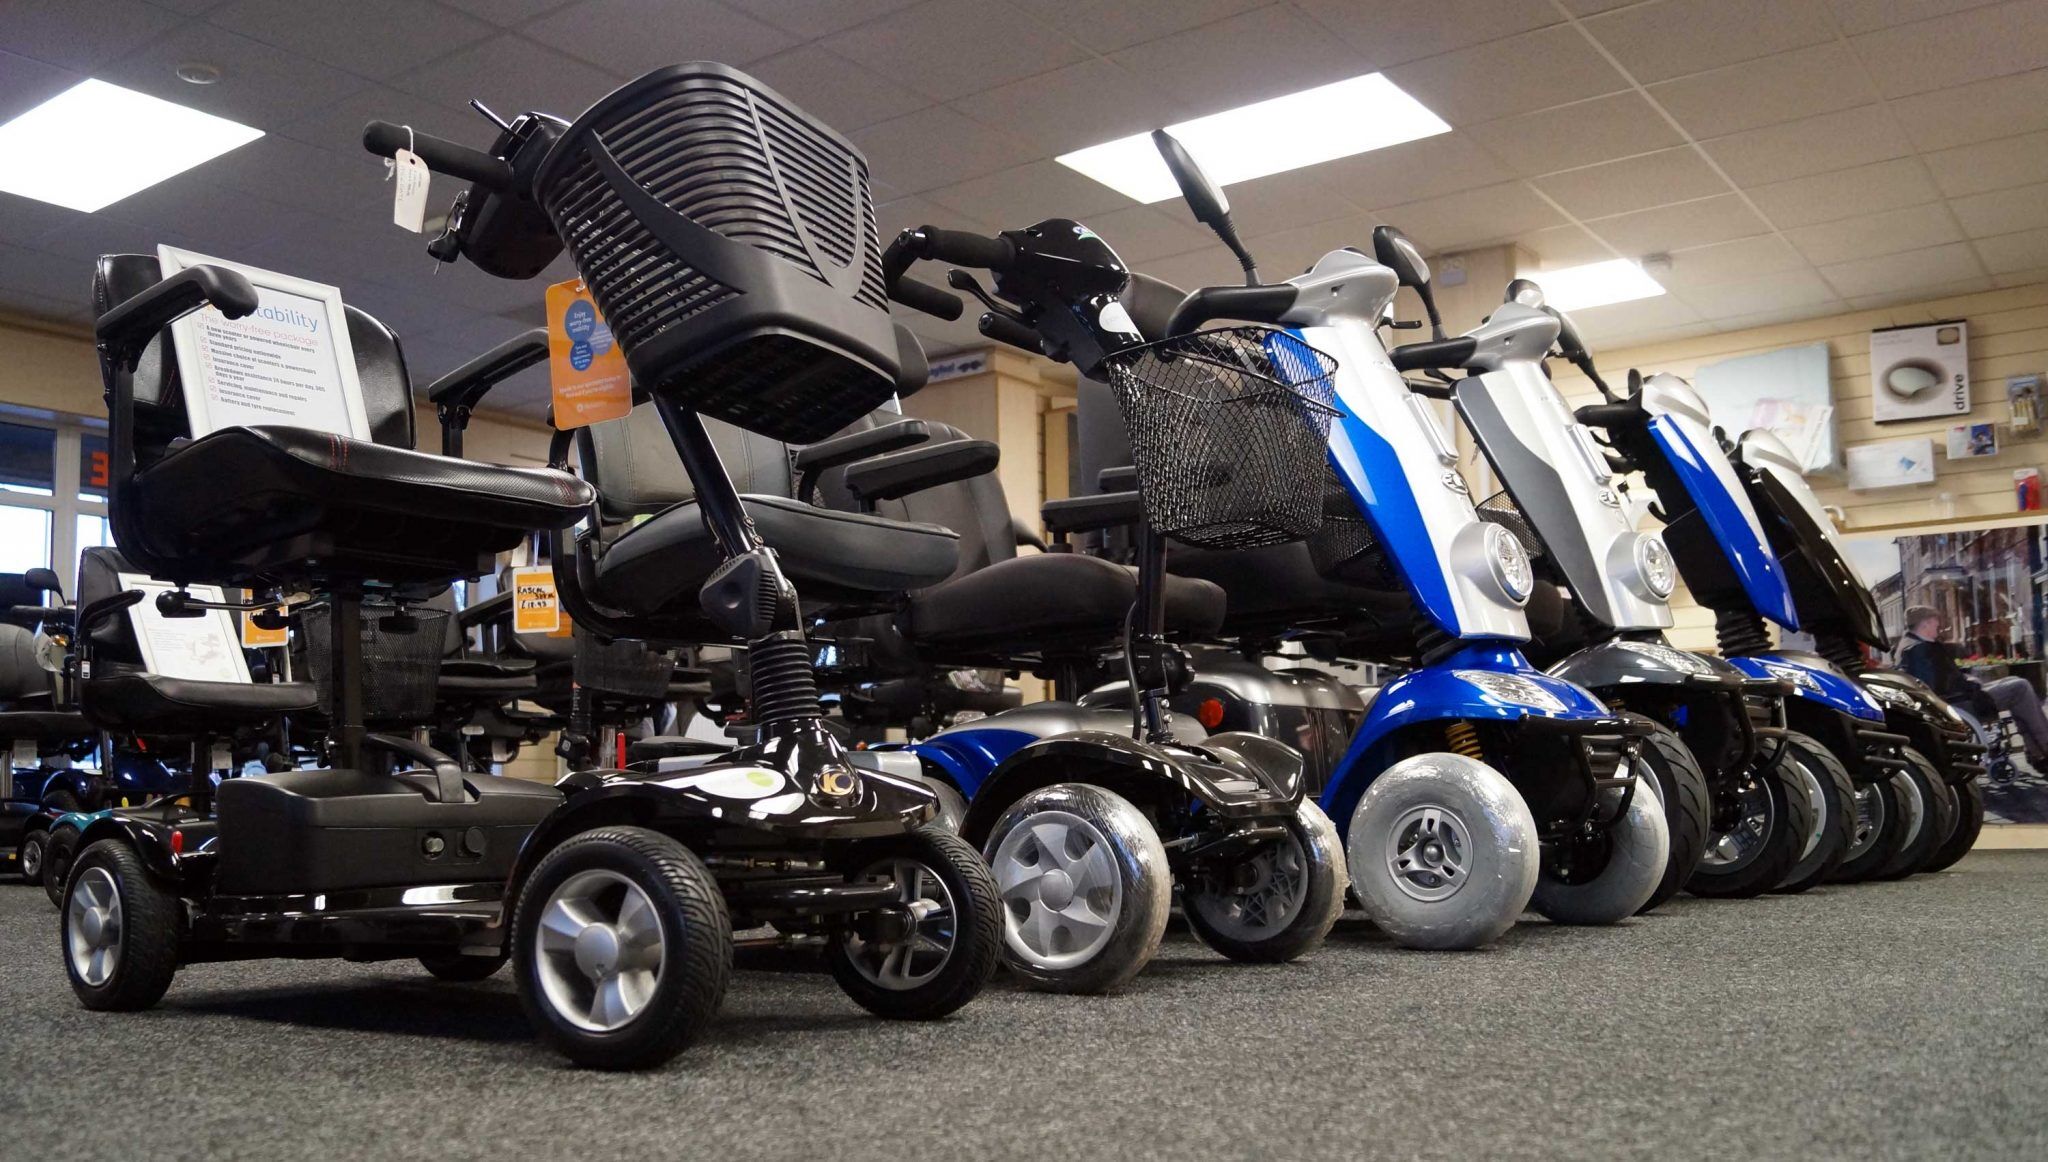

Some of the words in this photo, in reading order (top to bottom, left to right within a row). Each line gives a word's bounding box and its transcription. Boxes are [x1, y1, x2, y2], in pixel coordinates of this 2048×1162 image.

[256, 306, 318, 333] tability
[209, 339, 233, 349] Standard
[233, 345, 252, 353] pricing
[233, 352, 250, 361] choice
[1954, 374, 1964, 410] drive
